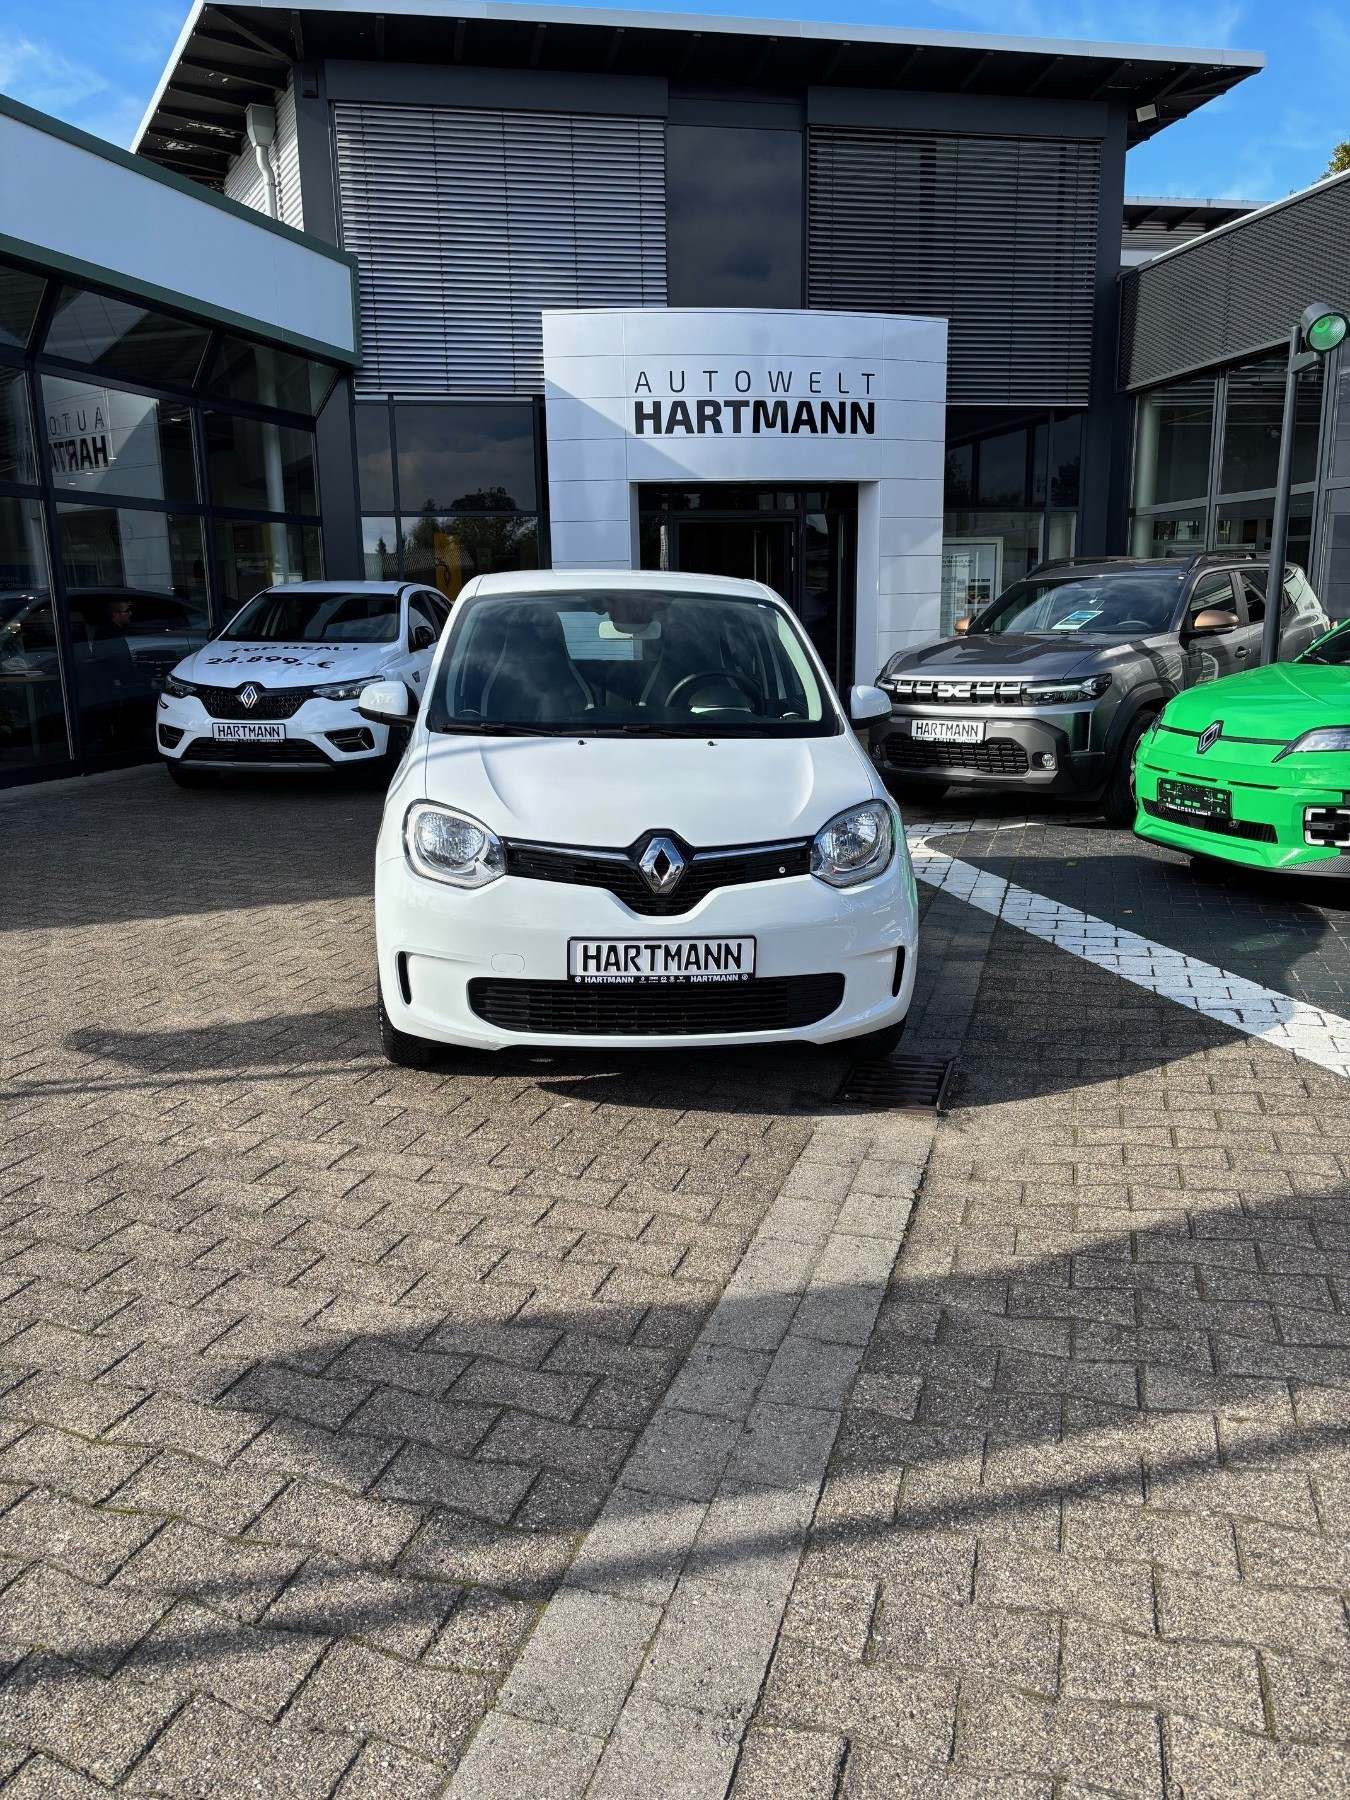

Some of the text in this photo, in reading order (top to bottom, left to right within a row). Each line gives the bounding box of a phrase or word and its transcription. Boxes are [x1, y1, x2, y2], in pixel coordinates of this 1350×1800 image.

[634, 370, 876, 395] AUTOWELT
[634, 399, 876, 435] HARTMANN
[217, 725, 280, 738] HARTMANN
[915, 721, 979, 738] HARTMANN
[582, 942, 742, 972] HARTMANN
[584, 976, 634, 984] HARTMANN
[690, 974, 739, 983] HARTMANN
